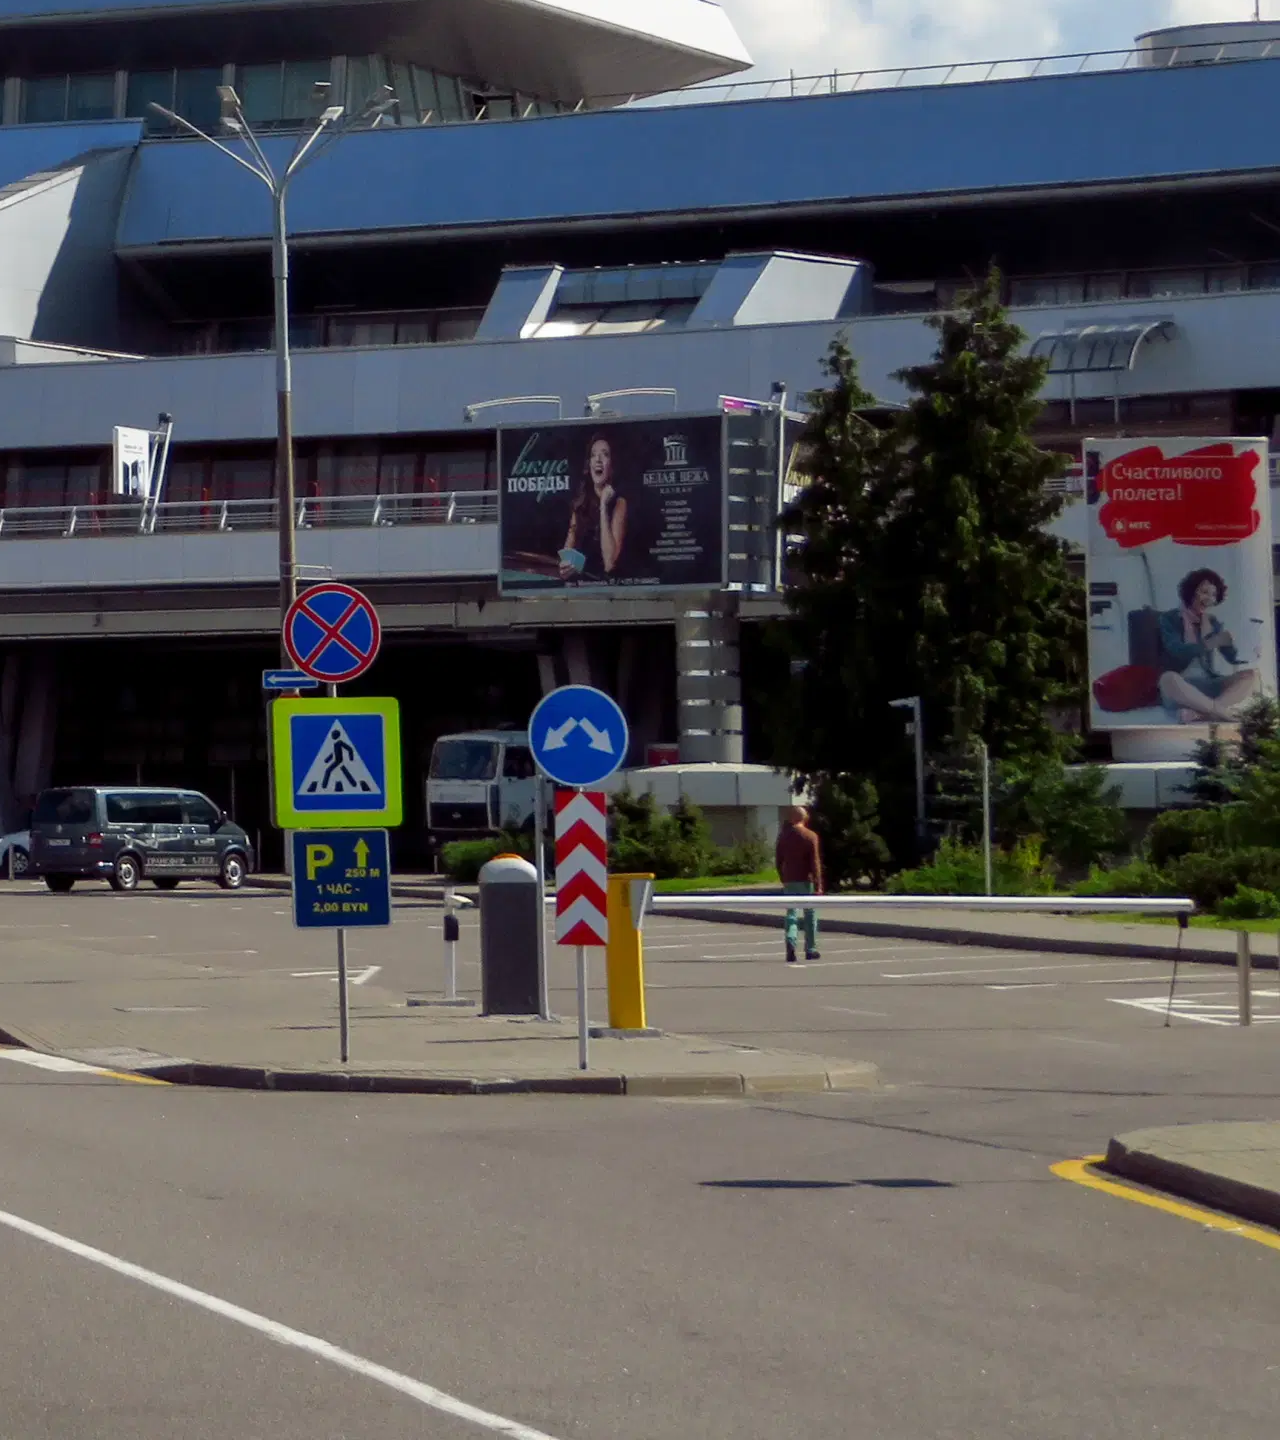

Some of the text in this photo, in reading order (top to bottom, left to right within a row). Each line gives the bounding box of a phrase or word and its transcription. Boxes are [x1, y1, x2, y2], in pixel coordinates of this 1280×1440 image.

[1112, 464, 1223, 480] Счастливого
[507, 475, 570, 493] ПОБЕДЫ
[1112, 484, 1182, 501] полета!
[306, 844, 333, 880] P
[345, 868, 366, 878] 250
[326, 883, 352, 894] ЧАС
[313, 902, 368, 913] 2,00 BYN
